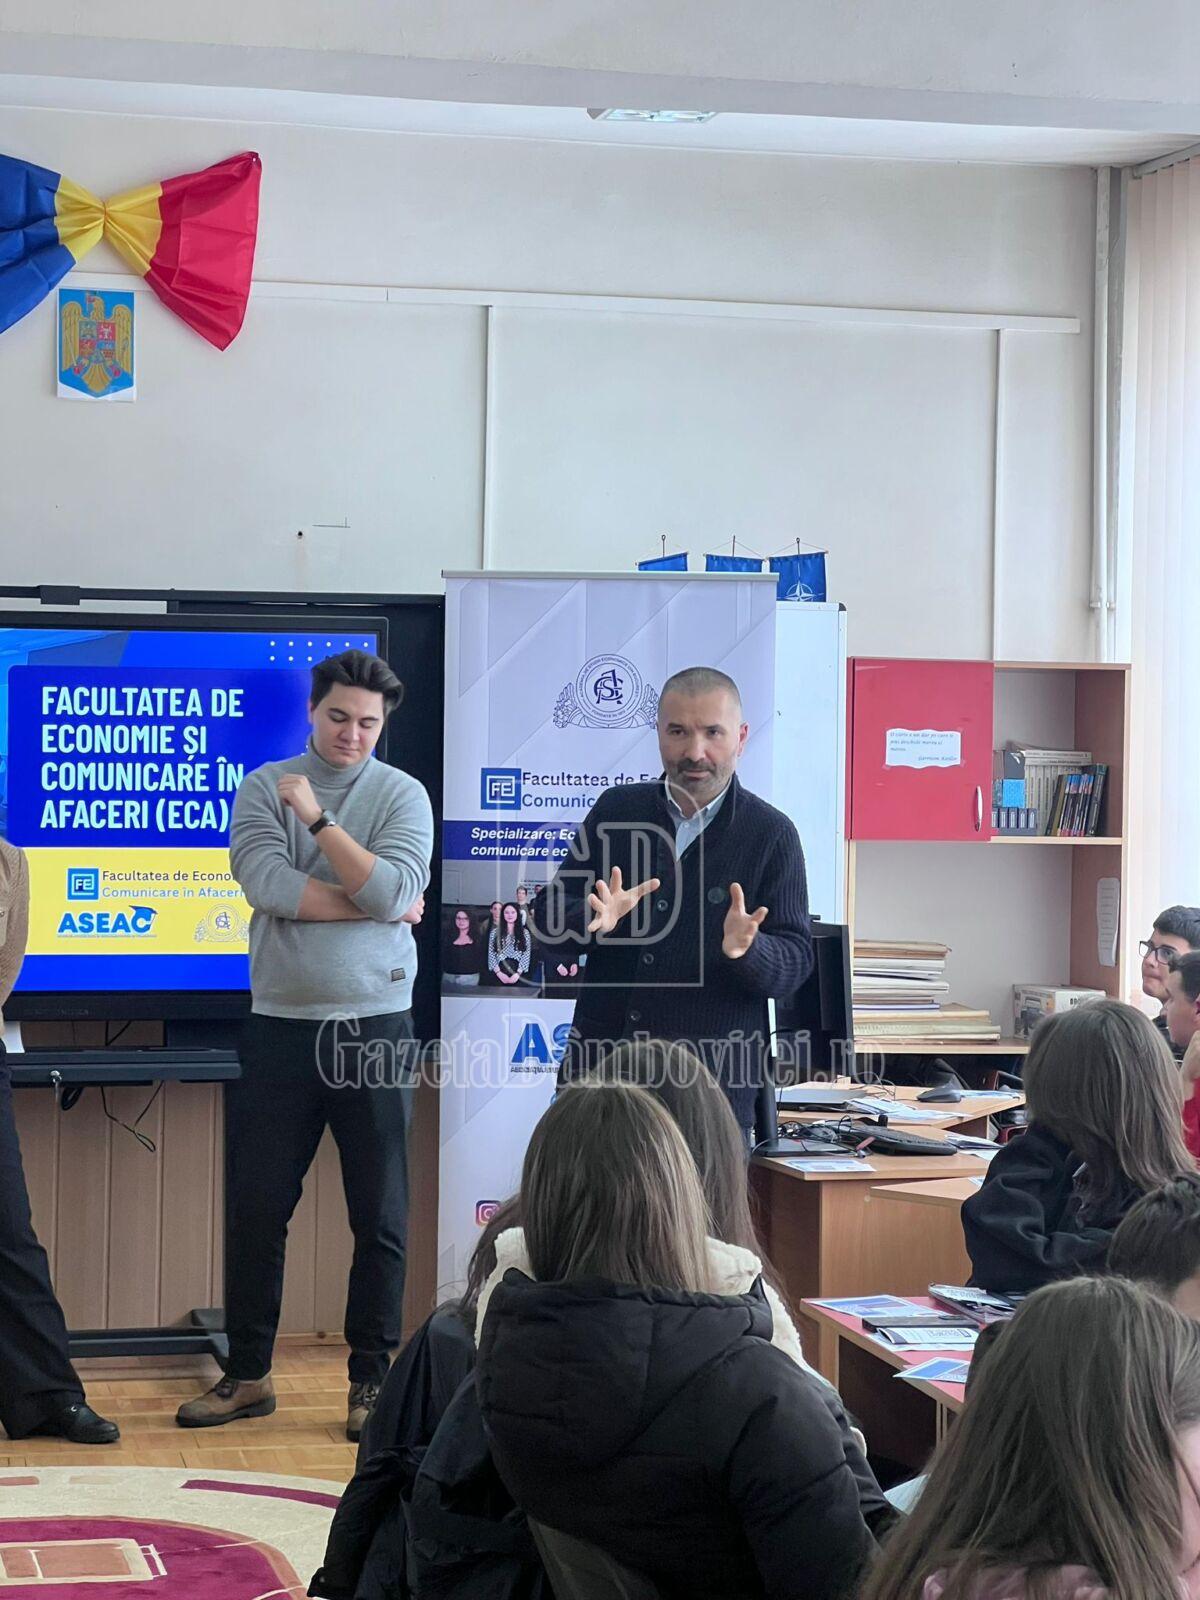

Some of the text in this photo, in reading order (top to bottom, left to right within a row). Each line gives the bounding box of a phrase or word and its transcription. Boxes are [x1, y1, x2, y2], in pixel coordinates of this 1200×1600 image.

[42, 686, 244, 717] FACULTATEA DE
[42, 724, 207, 761] ECONOMIE ȘI
[41, 756, 244, 792] COMUNICARE ÎN
[522, 771, 609, 787] Facultatea
[614, 772, 634, 786] de
[40, 798, 229, 833] AFACERI (ECA)
[471, 827, 576, 841] Specializare: Ec
[471, 845, 568, 857] comunicare ec
[102, 870, 169, 881] Facultatea
[173, 870, 189, 881] de
[102, 887, 179, 898] Comunicare
[58, 907, 156, 933] ASEAC
